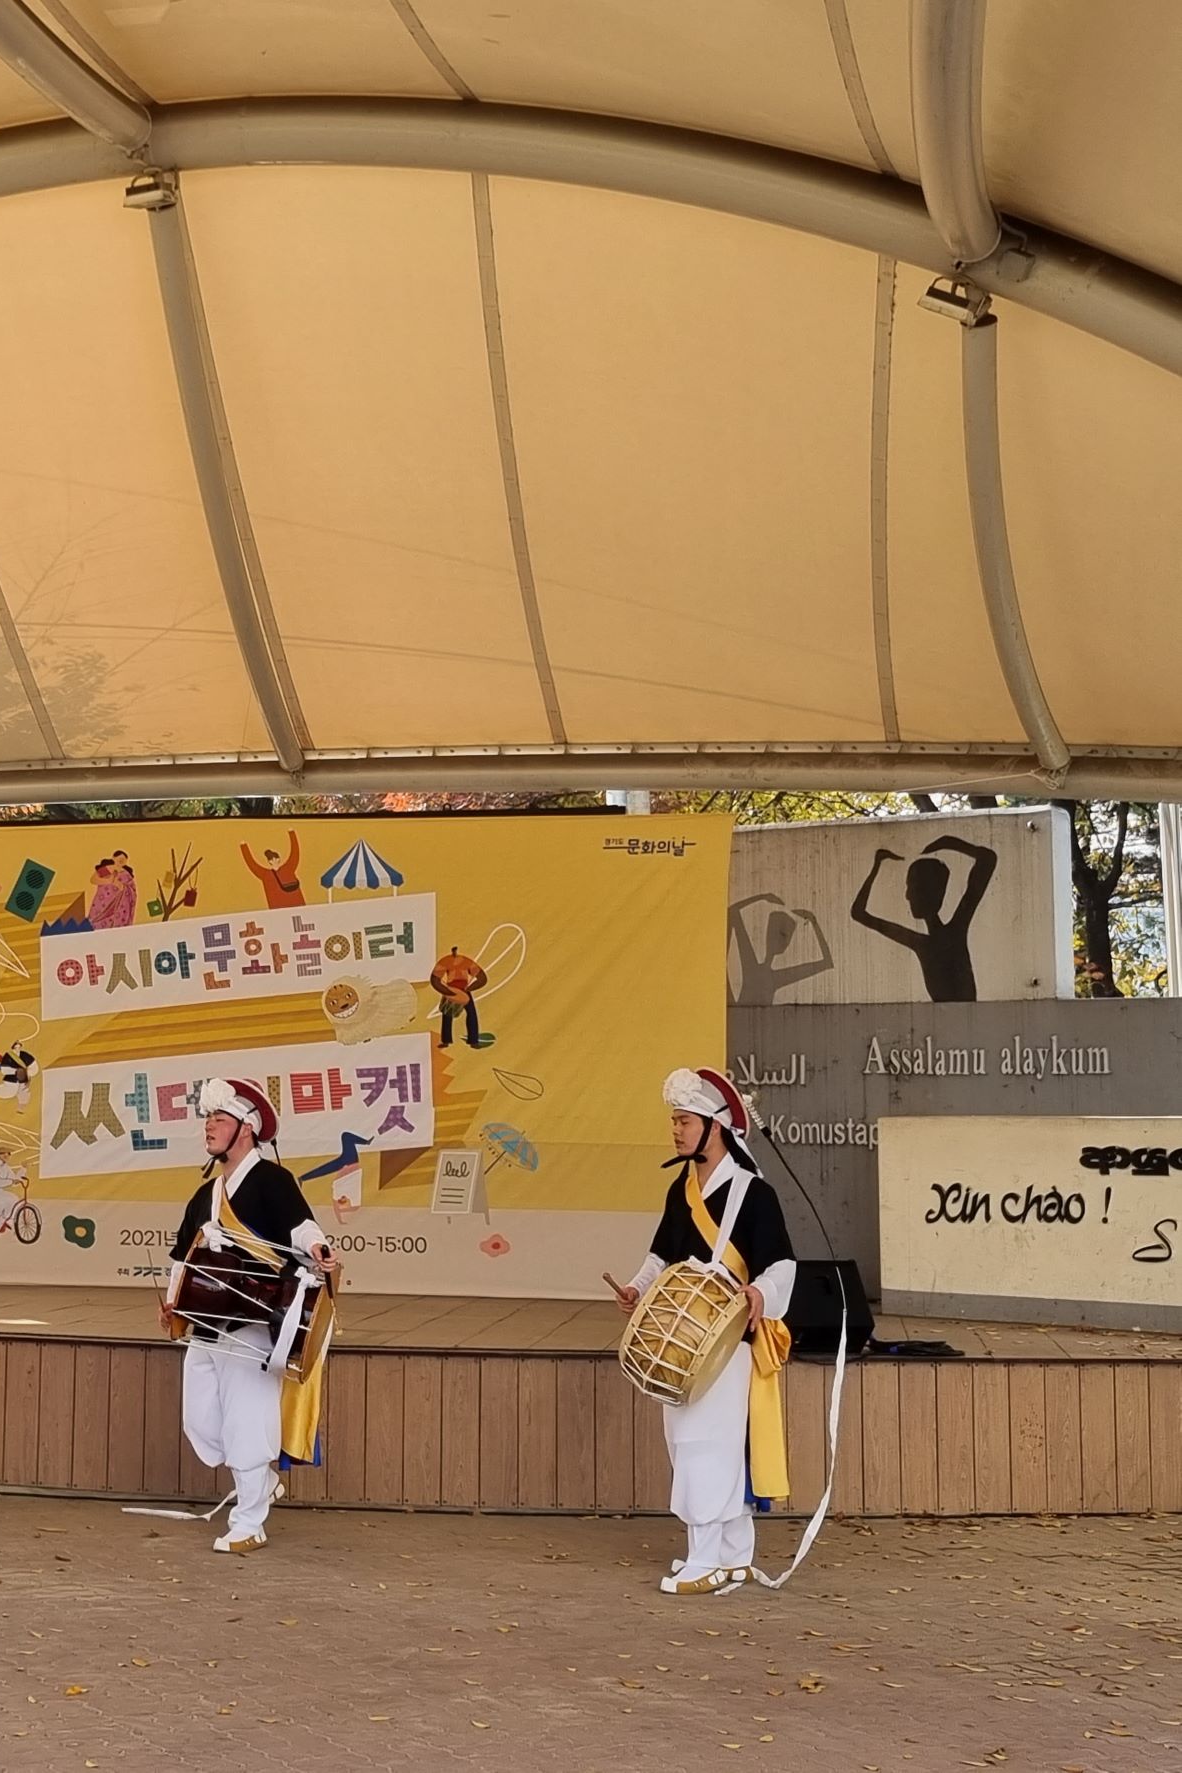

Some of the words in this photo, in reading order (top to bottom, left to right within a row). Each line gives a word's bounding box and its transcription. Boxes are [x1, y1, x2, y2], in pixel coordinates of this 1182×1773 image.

[627, 836, 684, 856] 문화의날
[864, 1037, 986, 1075] Assalamu
[1001, 1036, 1111, 1079] alaykum
[925, 1183, 992, 1224] Xin
[1000, 1184, 1085, 1224] chào
